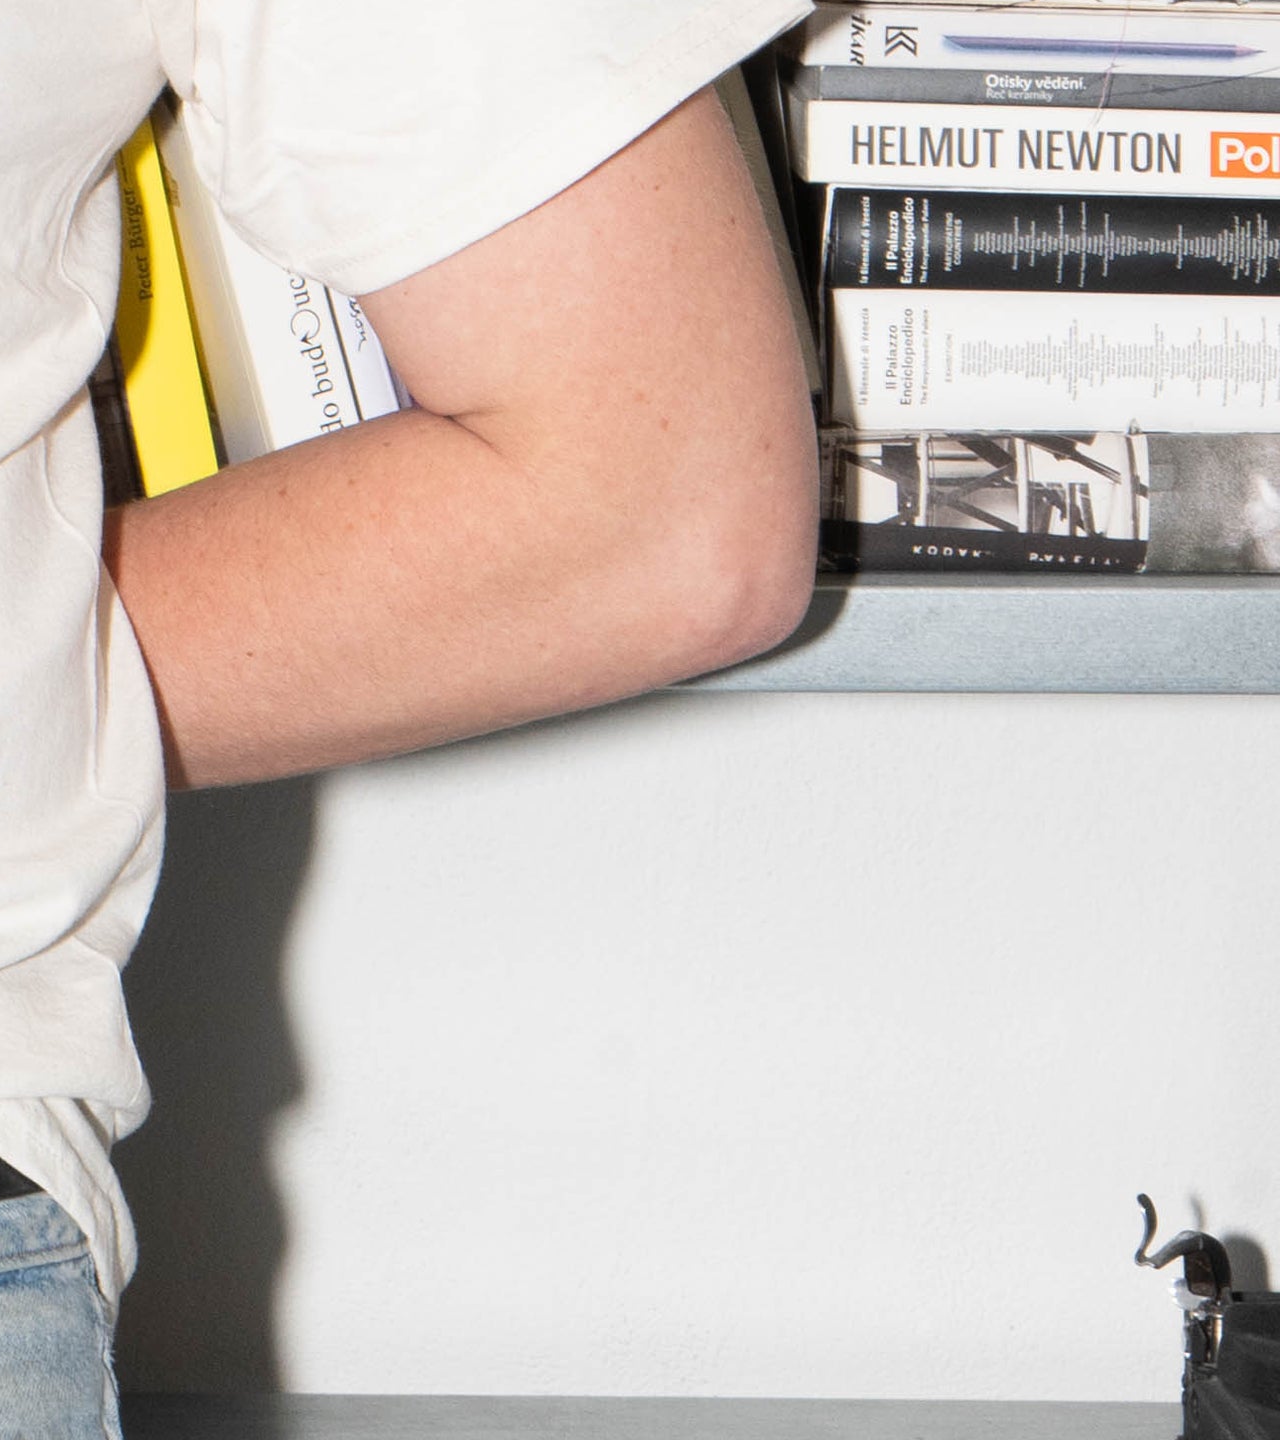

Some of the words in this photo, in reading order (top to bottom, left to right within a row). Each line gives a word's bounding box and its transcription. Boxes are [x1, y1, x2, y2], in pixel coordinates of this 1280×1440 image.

[984, 73, 1034, 94] Otisky
[851, 125, 1004, 169] HELMUT
[1018, 129, 1181, 174] NEWTON
